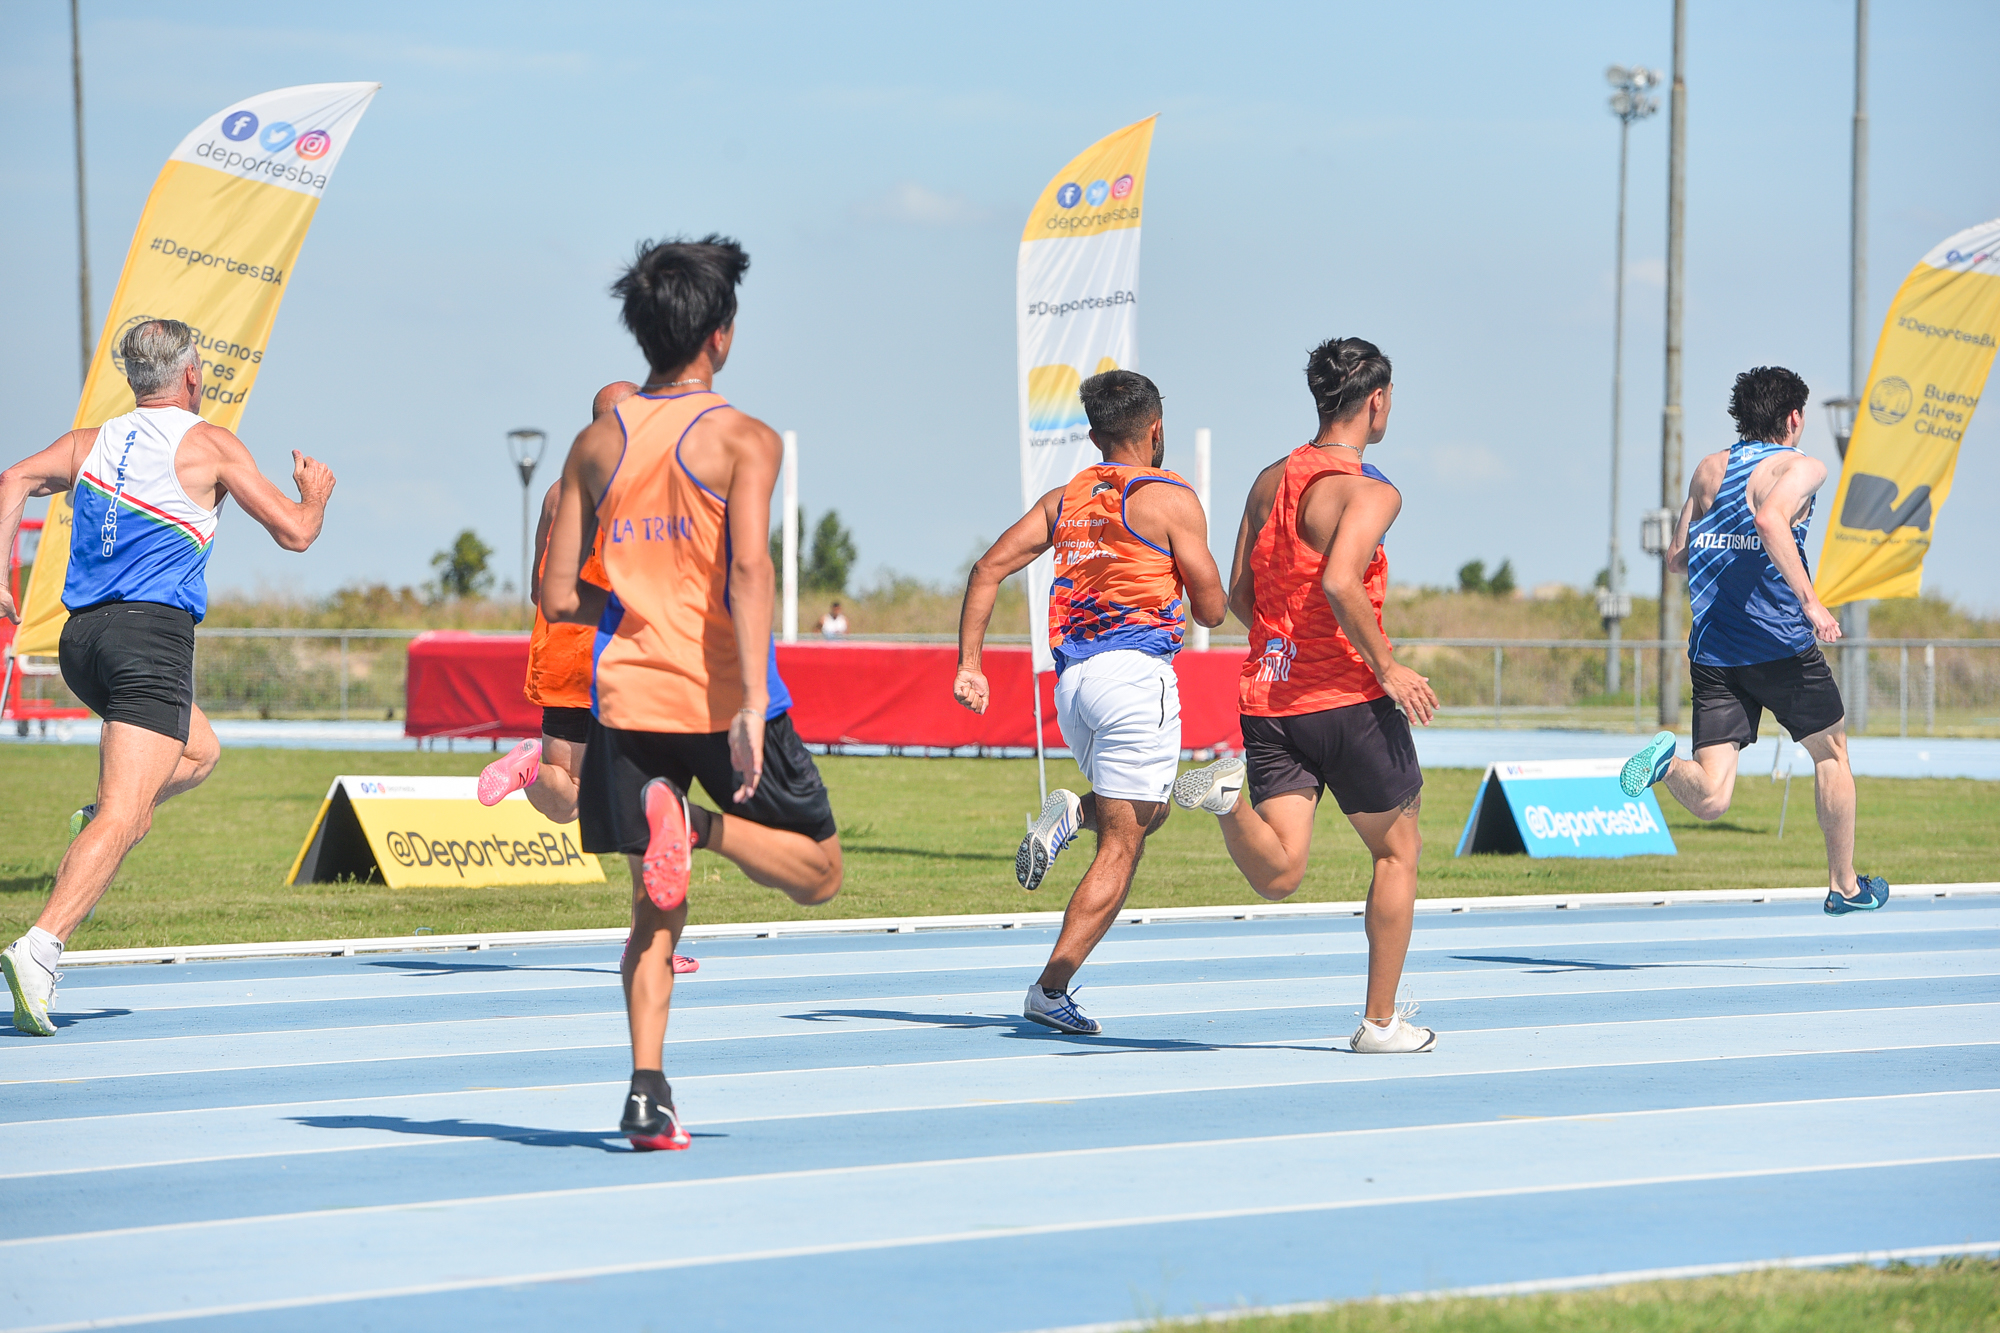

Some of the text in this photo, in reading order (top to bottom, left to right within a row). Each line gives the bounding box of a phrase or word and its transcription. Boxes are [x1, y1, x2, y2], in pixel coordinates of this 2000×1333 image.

[196, 140, 327, 189] deportesba
[1046, 206, 1139, 231] deportesba
[150, 236, 283, 286] #DeportesBA
[1028, 290, 1136, 317] #DeportesBA
[189, 325, 263, 364] Buenos
[1898, 316, 1996, 348] #DeportesBA
[199, 359, 235, 381] res
[1918, 402, 1963, 424] Aires
[1914, 419, 1961, 442] Ciuda
[102, 430, 137, 557] ATLETISMO
[612, 517, 635, 543] LA
[1059, 518, 1109, 528] ATLETISMO
[1055, 538, 1096, 551] unicipio
[1694, 533, 1760, 550] ATLETISMO
[1054, 552, 1062, 565] a
[1282, 636, 1297, 660] LA
[1255, 656, 1290, 682] TRIBU
[1525, 801, 1660, 847] @DeportesBA
[387, 831, 585, 878] @DeportesBA
